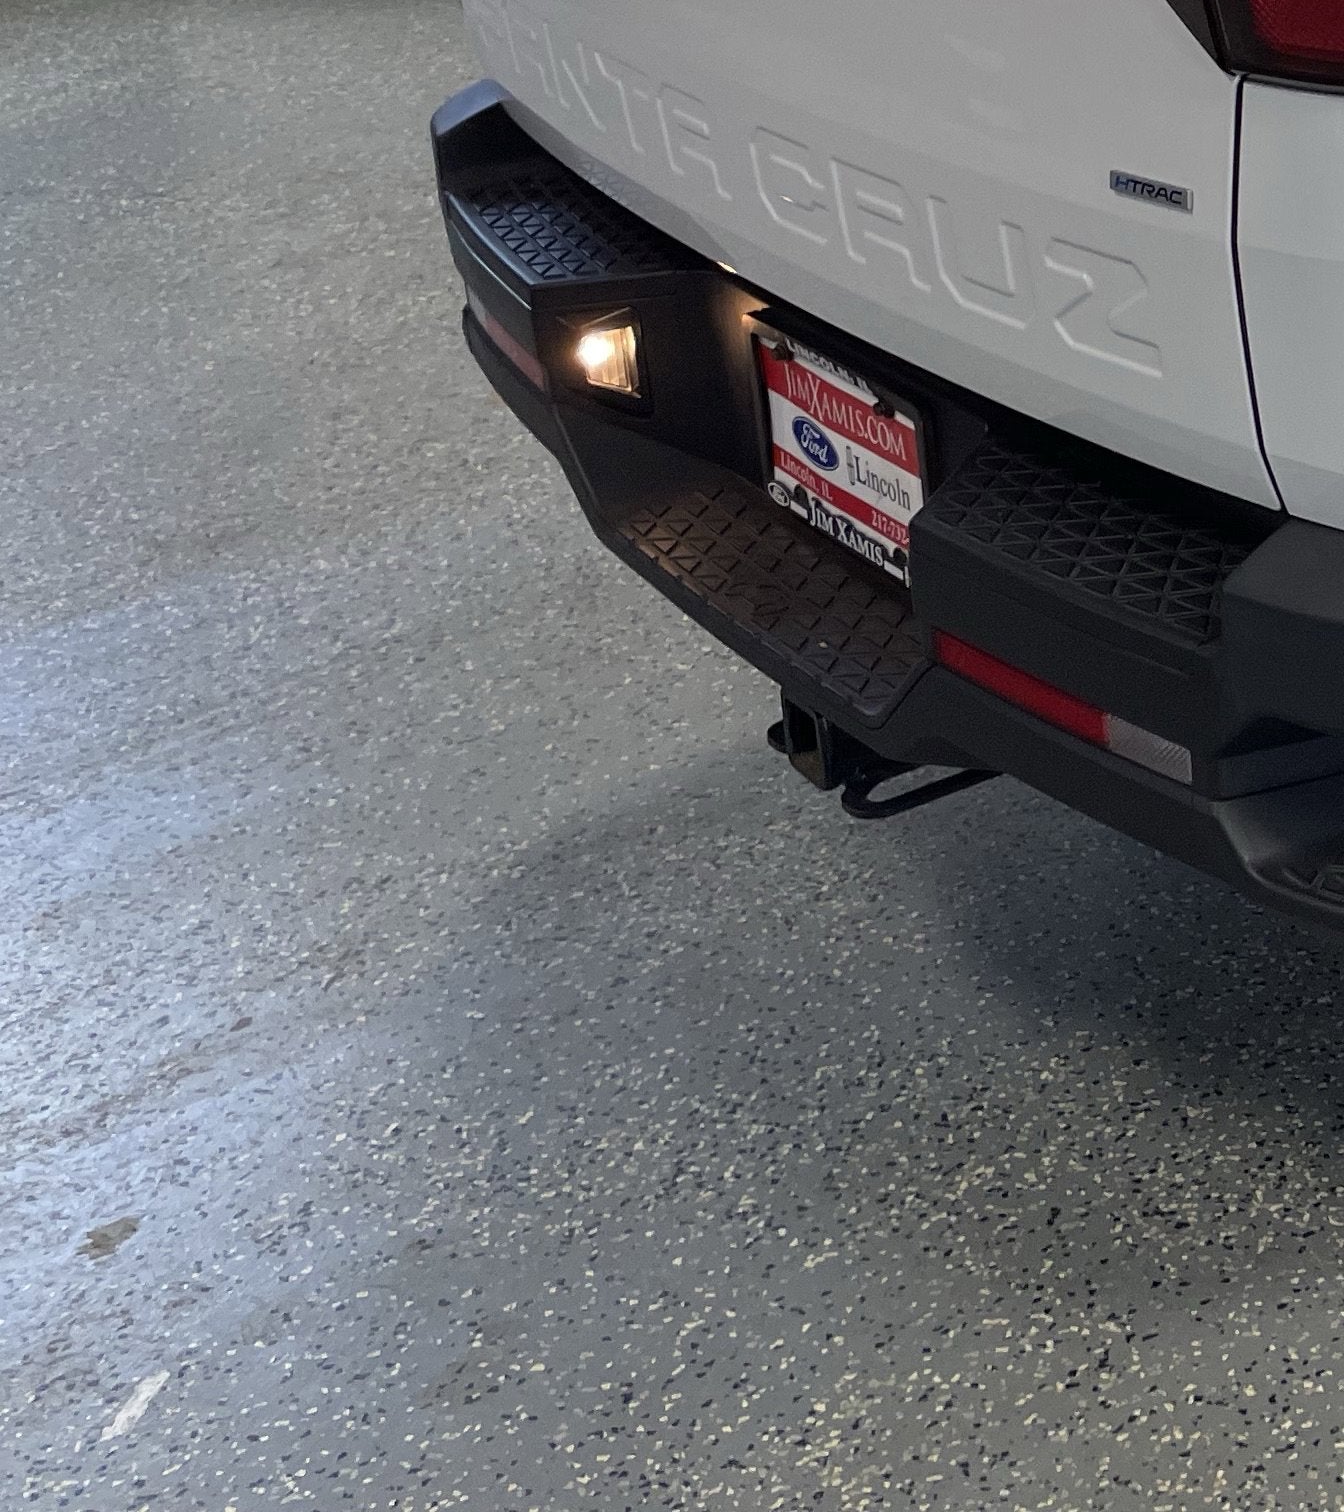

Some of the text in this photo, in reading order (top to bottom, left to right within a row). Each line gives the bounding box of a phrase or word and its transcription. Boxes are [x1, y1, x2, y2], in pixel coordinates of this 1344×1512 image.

[1115, 175, 1182, 205] HTRAC
[853, 454, 912, 511] Lincoln
[809, 499, 885, 567] JIM XAMIS
